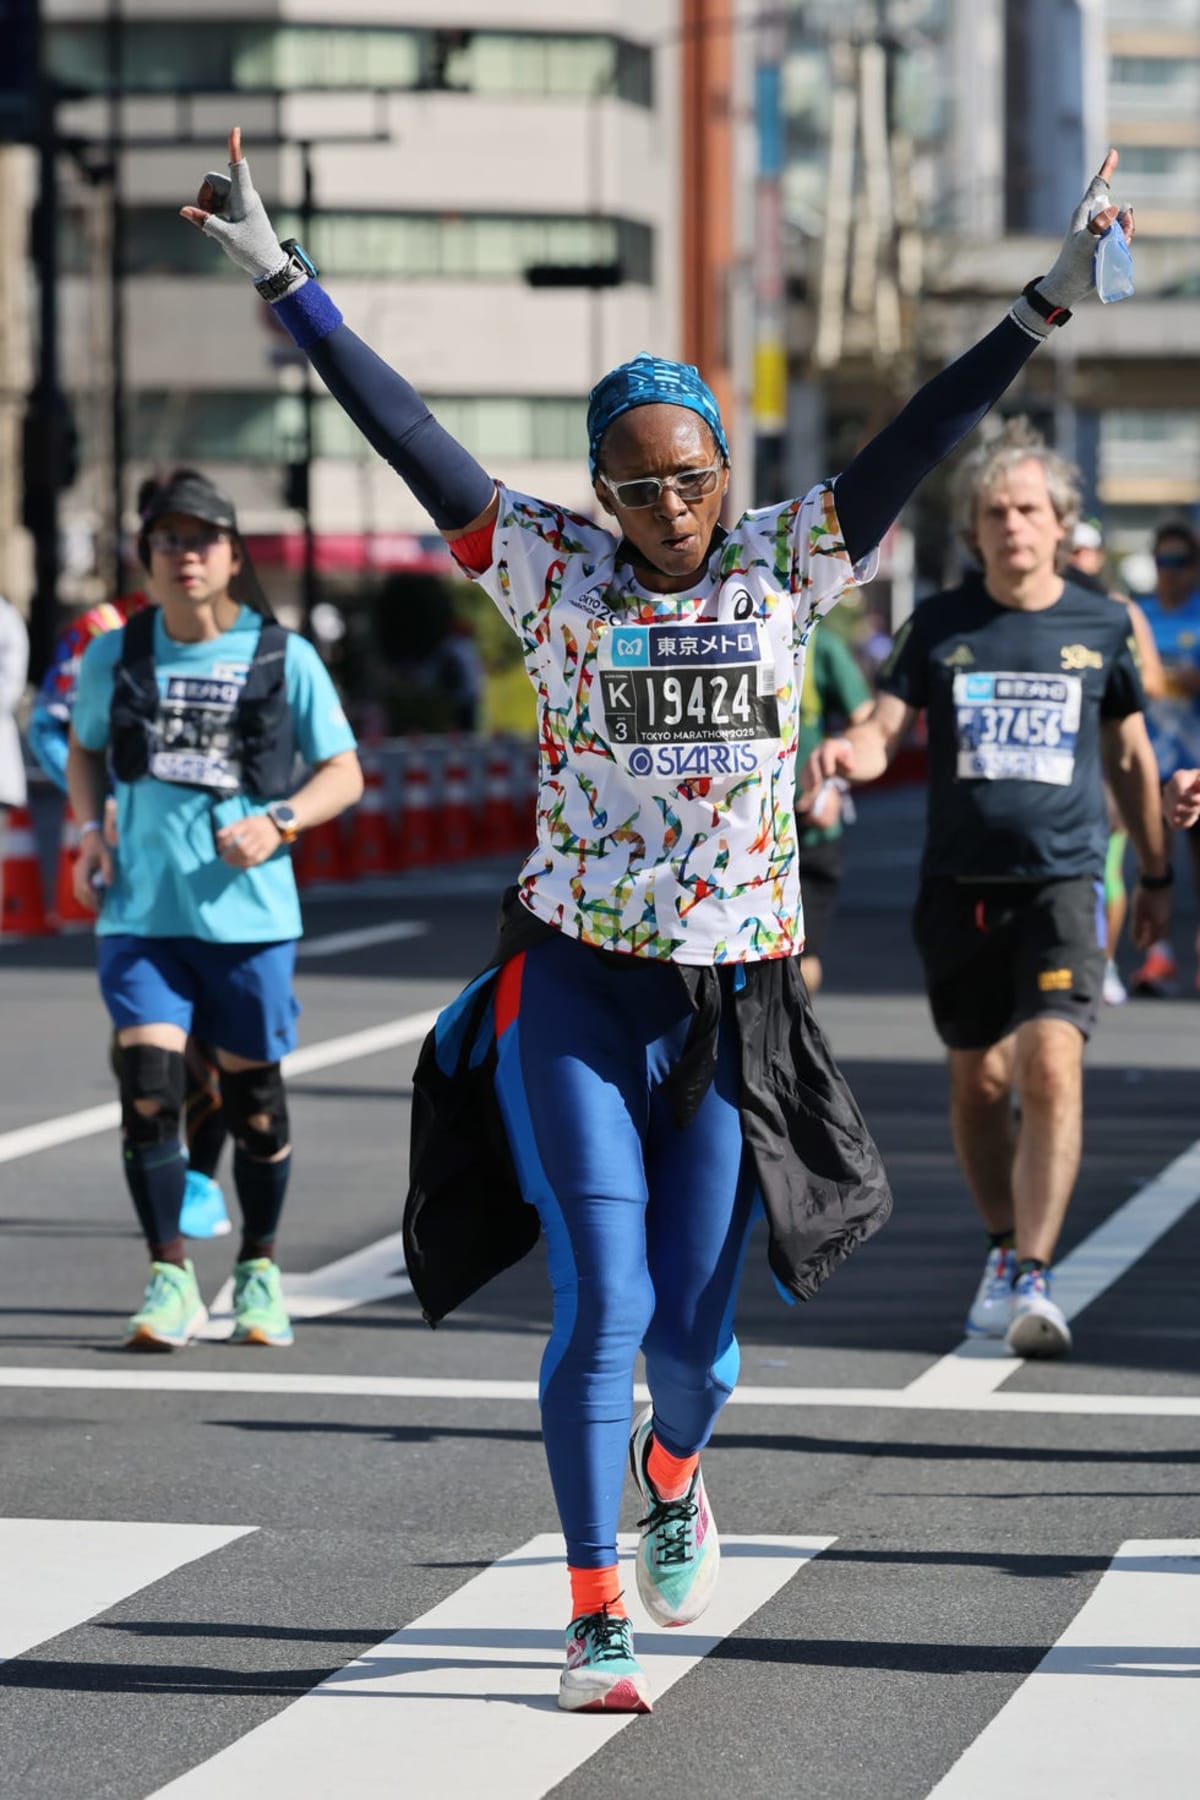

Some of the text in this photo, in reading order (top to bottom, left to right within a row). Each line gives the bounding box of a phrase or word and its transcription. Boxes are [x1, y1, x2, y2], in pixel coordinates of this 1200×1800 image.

[657, 633, 753, 656] 東京メトロ
[608, 682, 632, 708] K
[646, 673, 751, 727] 19424
[615, 721, 628, 741] 3
[641, 730, 672, 742] TOKYO
[981, 706, 1063, 746] 37456
[656, 743, 758, 775] STARTS
